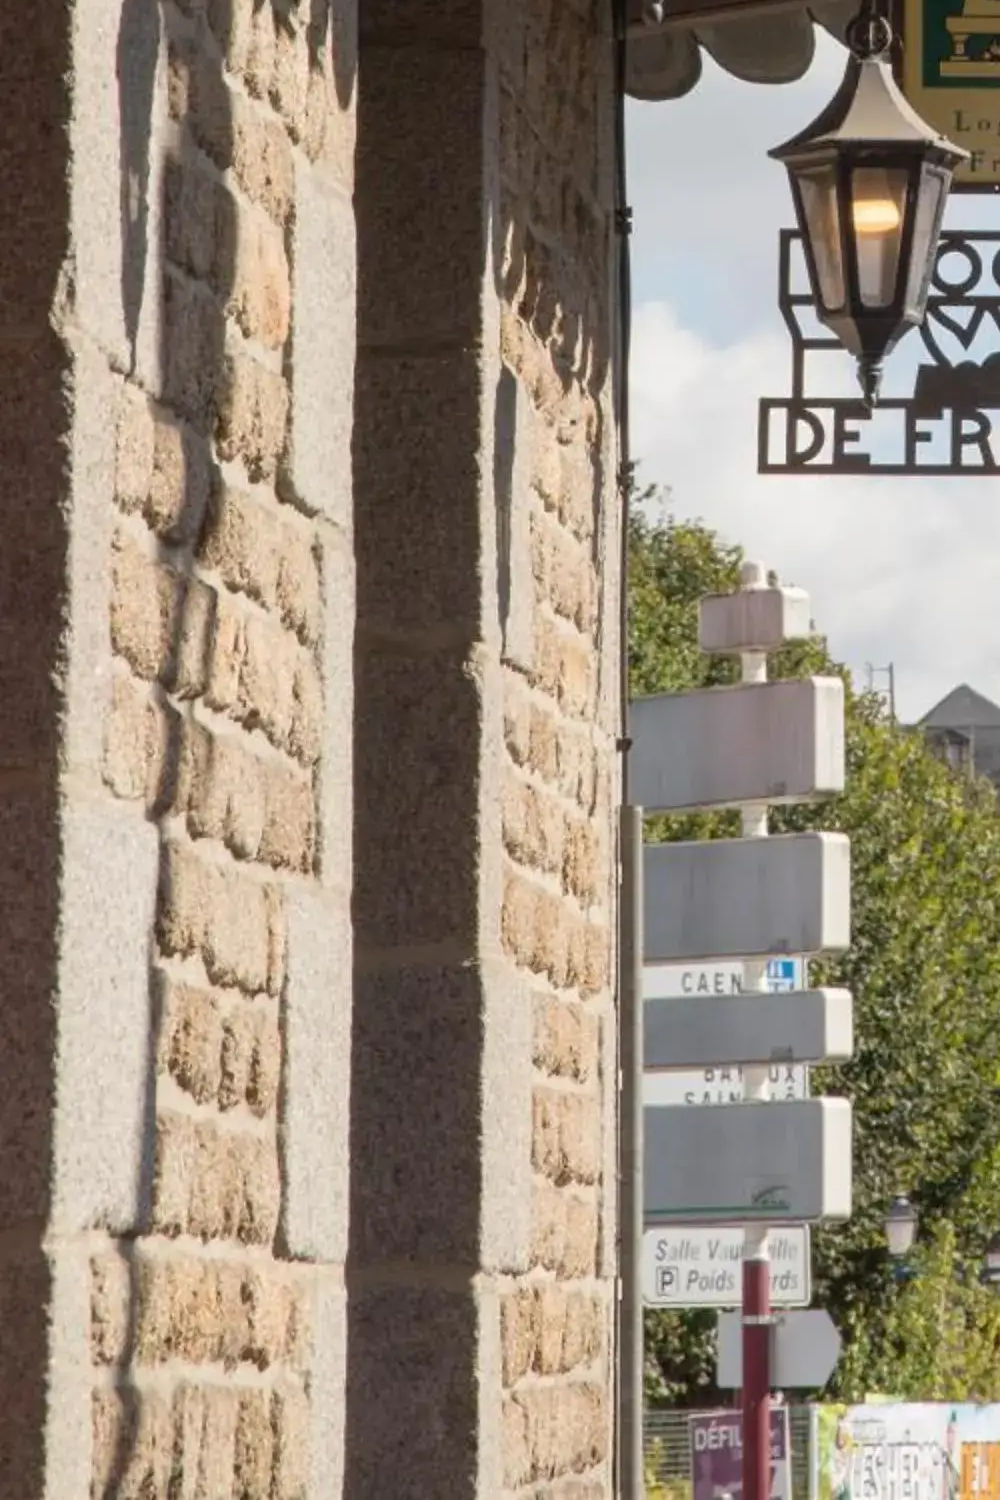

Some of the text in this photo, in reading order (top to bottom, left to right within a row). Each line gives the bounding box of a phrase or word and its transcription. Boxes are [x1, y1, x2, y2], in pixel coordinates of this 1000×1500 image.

[788, 404, 871, 467] DE
[681, 972, 743, 994] CAEN
[655, 1239, 700, 1262] Salle
[686, 1268, 735, 1291] Poids
[694, 1419, 742, 1450] DÉFIL
